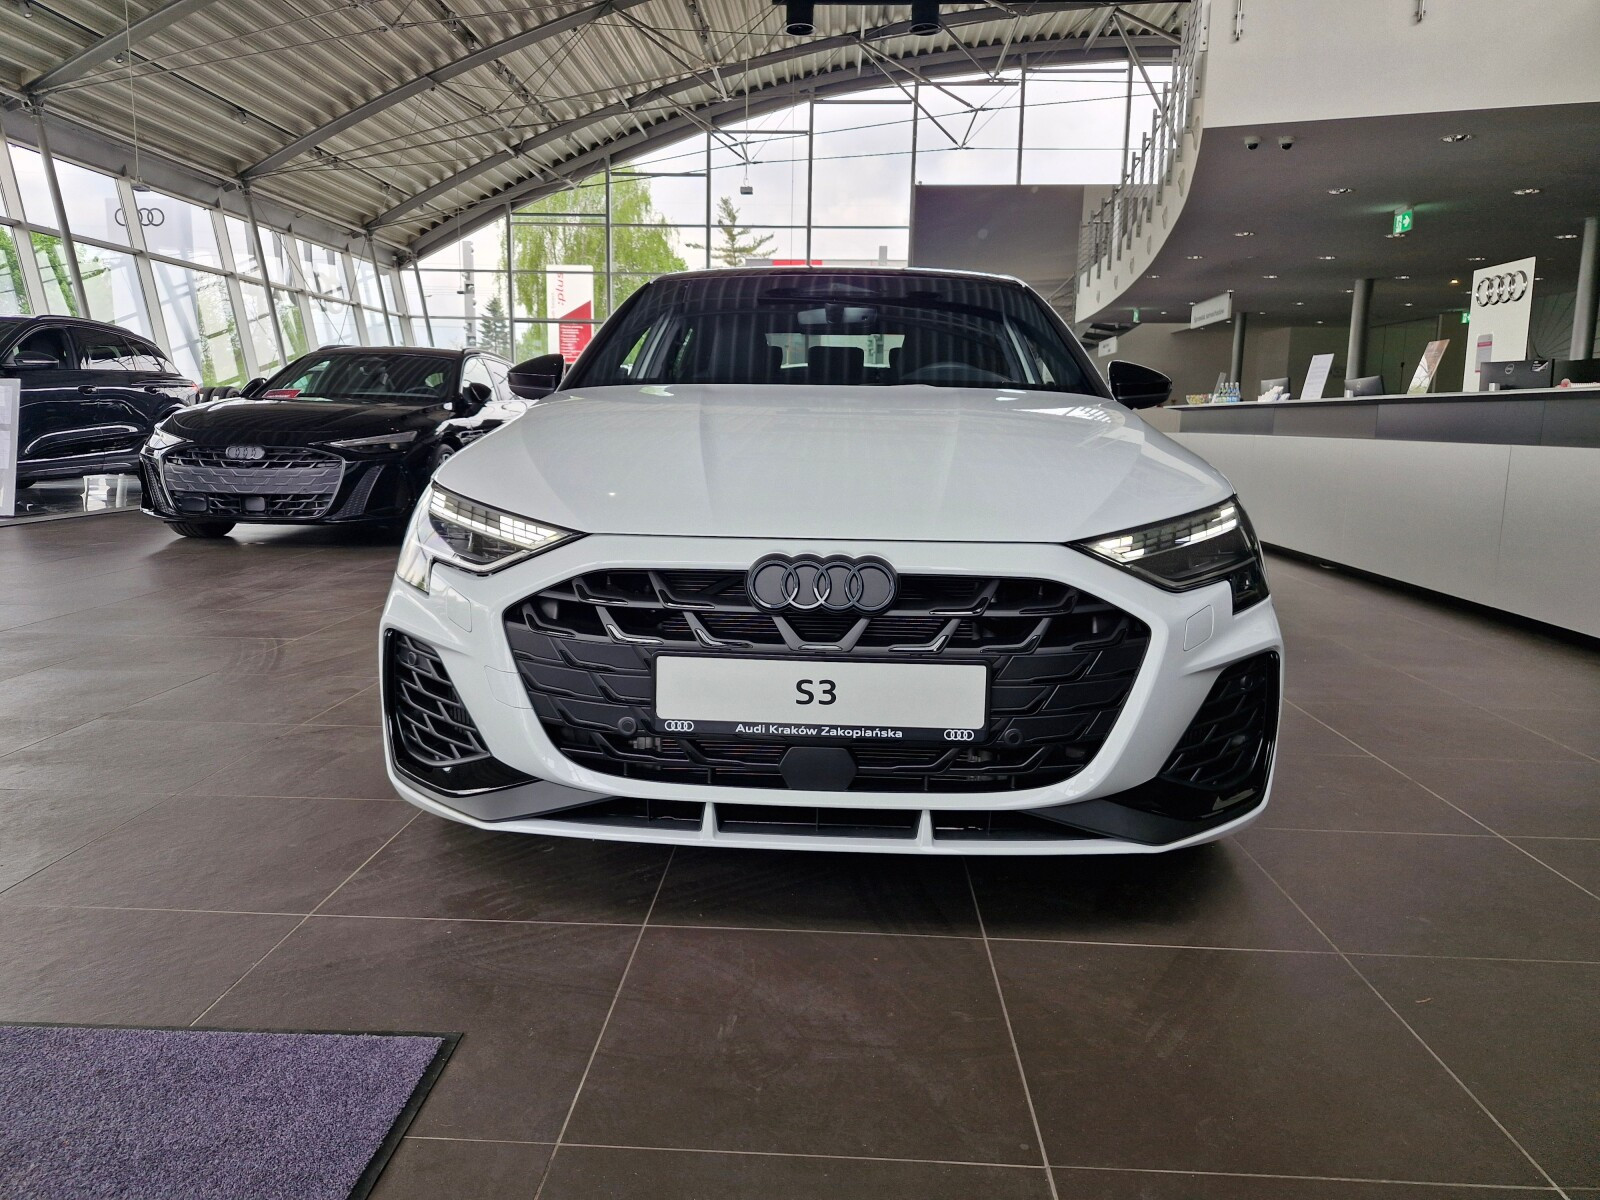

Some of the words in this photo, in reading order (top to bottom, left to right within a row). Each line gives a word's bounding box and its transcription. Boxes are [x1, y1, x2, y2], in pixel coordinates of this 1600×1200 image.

[795, 679, 837, 705] S3
[735, 723, 766, 733] Audi
[769, 724, 818, 736] Kraków
[820, 726, 903, 739] Zakopiańska
